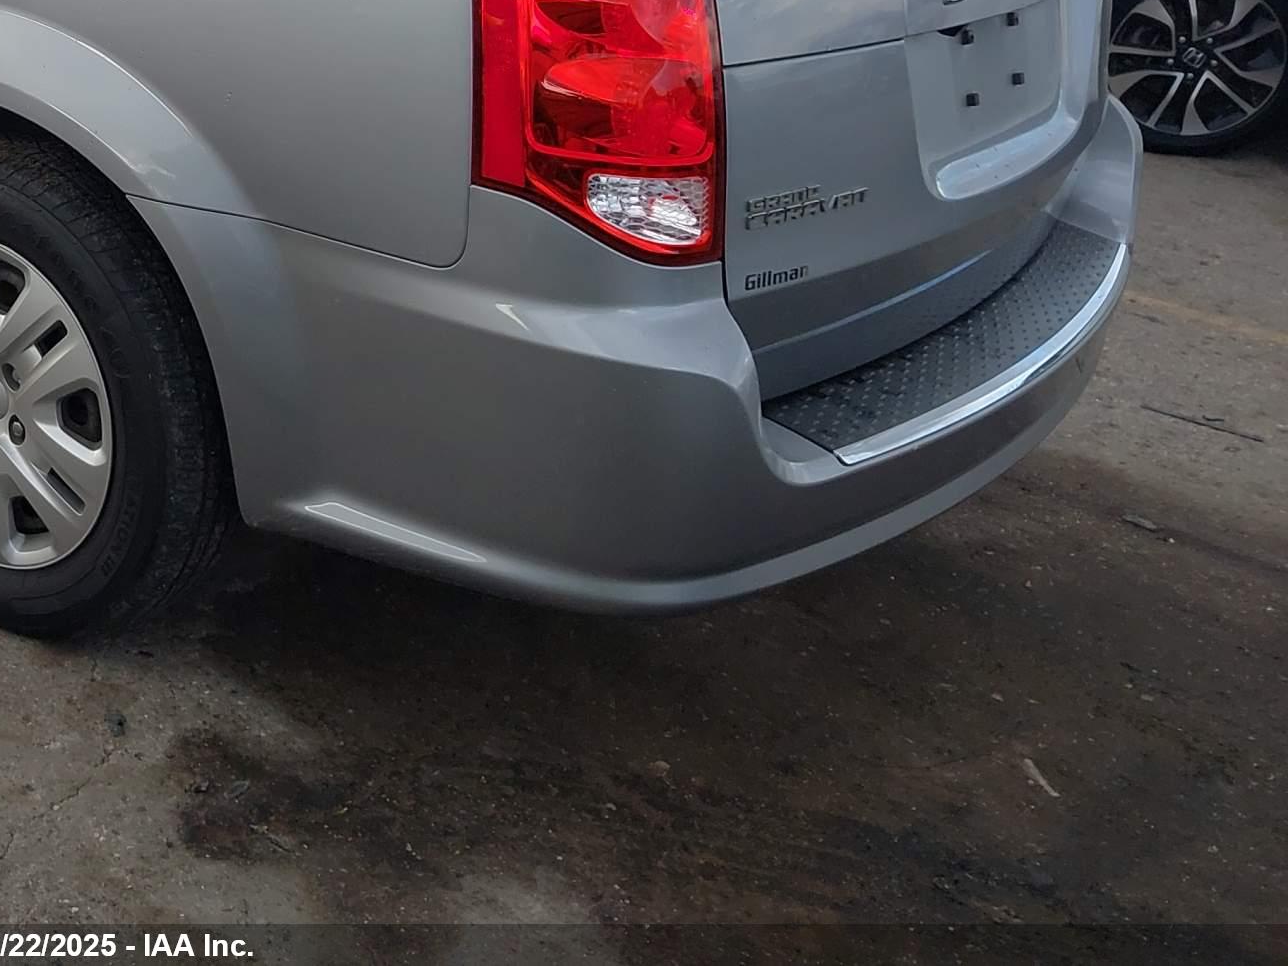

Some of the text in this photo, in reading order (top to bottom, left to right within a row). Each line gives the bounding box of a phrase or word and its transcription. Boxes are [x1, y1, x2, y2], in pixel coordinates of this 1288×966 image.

[745, 187, 870, 231] CARAVAN
[746, 184, 821, 212] GRAND
[745, 265, 809, 291] Gillman
